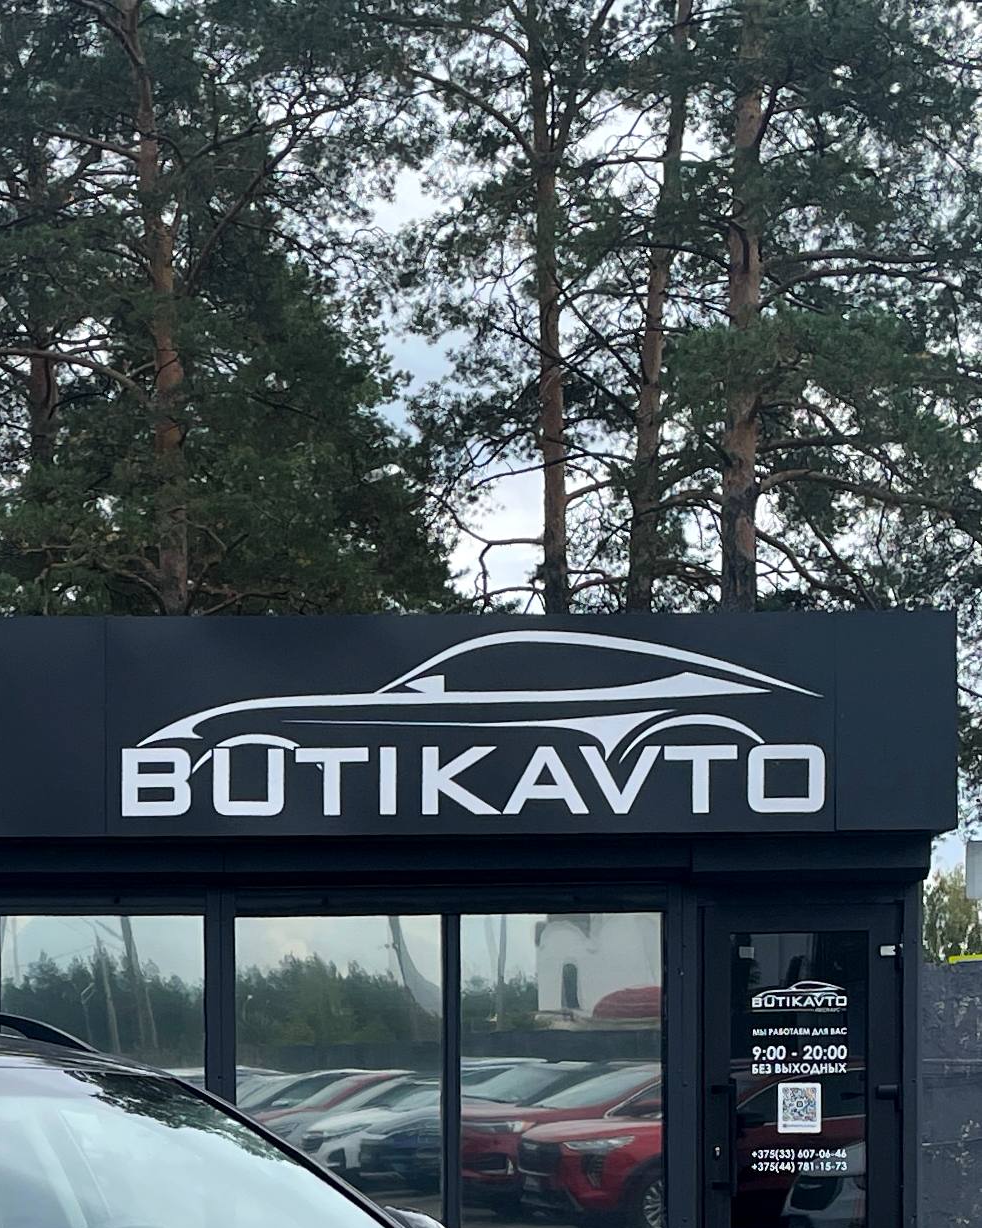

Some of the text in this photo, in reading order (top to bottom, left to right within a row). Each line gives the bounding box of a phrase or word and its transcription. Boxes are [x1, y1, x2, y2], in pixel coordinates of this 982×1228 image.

[121, 743, 826, 818] BUTIKAVTO
[751, 995, 847, 1008] BUTIKAVTO
[752, 1027, 848, 1036] МЫ РАБОТАЕМ ДЛЯ ВАС
[752, 1045, 786, 1060] 9:00
[802, 1045, 848, 1060] 20:00
[751, 1062, 847, 1075] БЕЗ ВЫХОДНЫХ
[751, 1149, 847, 1160] +375(33) 607-06-46
[751, 1161, 848, 1173] +375(44) 781-15-73
